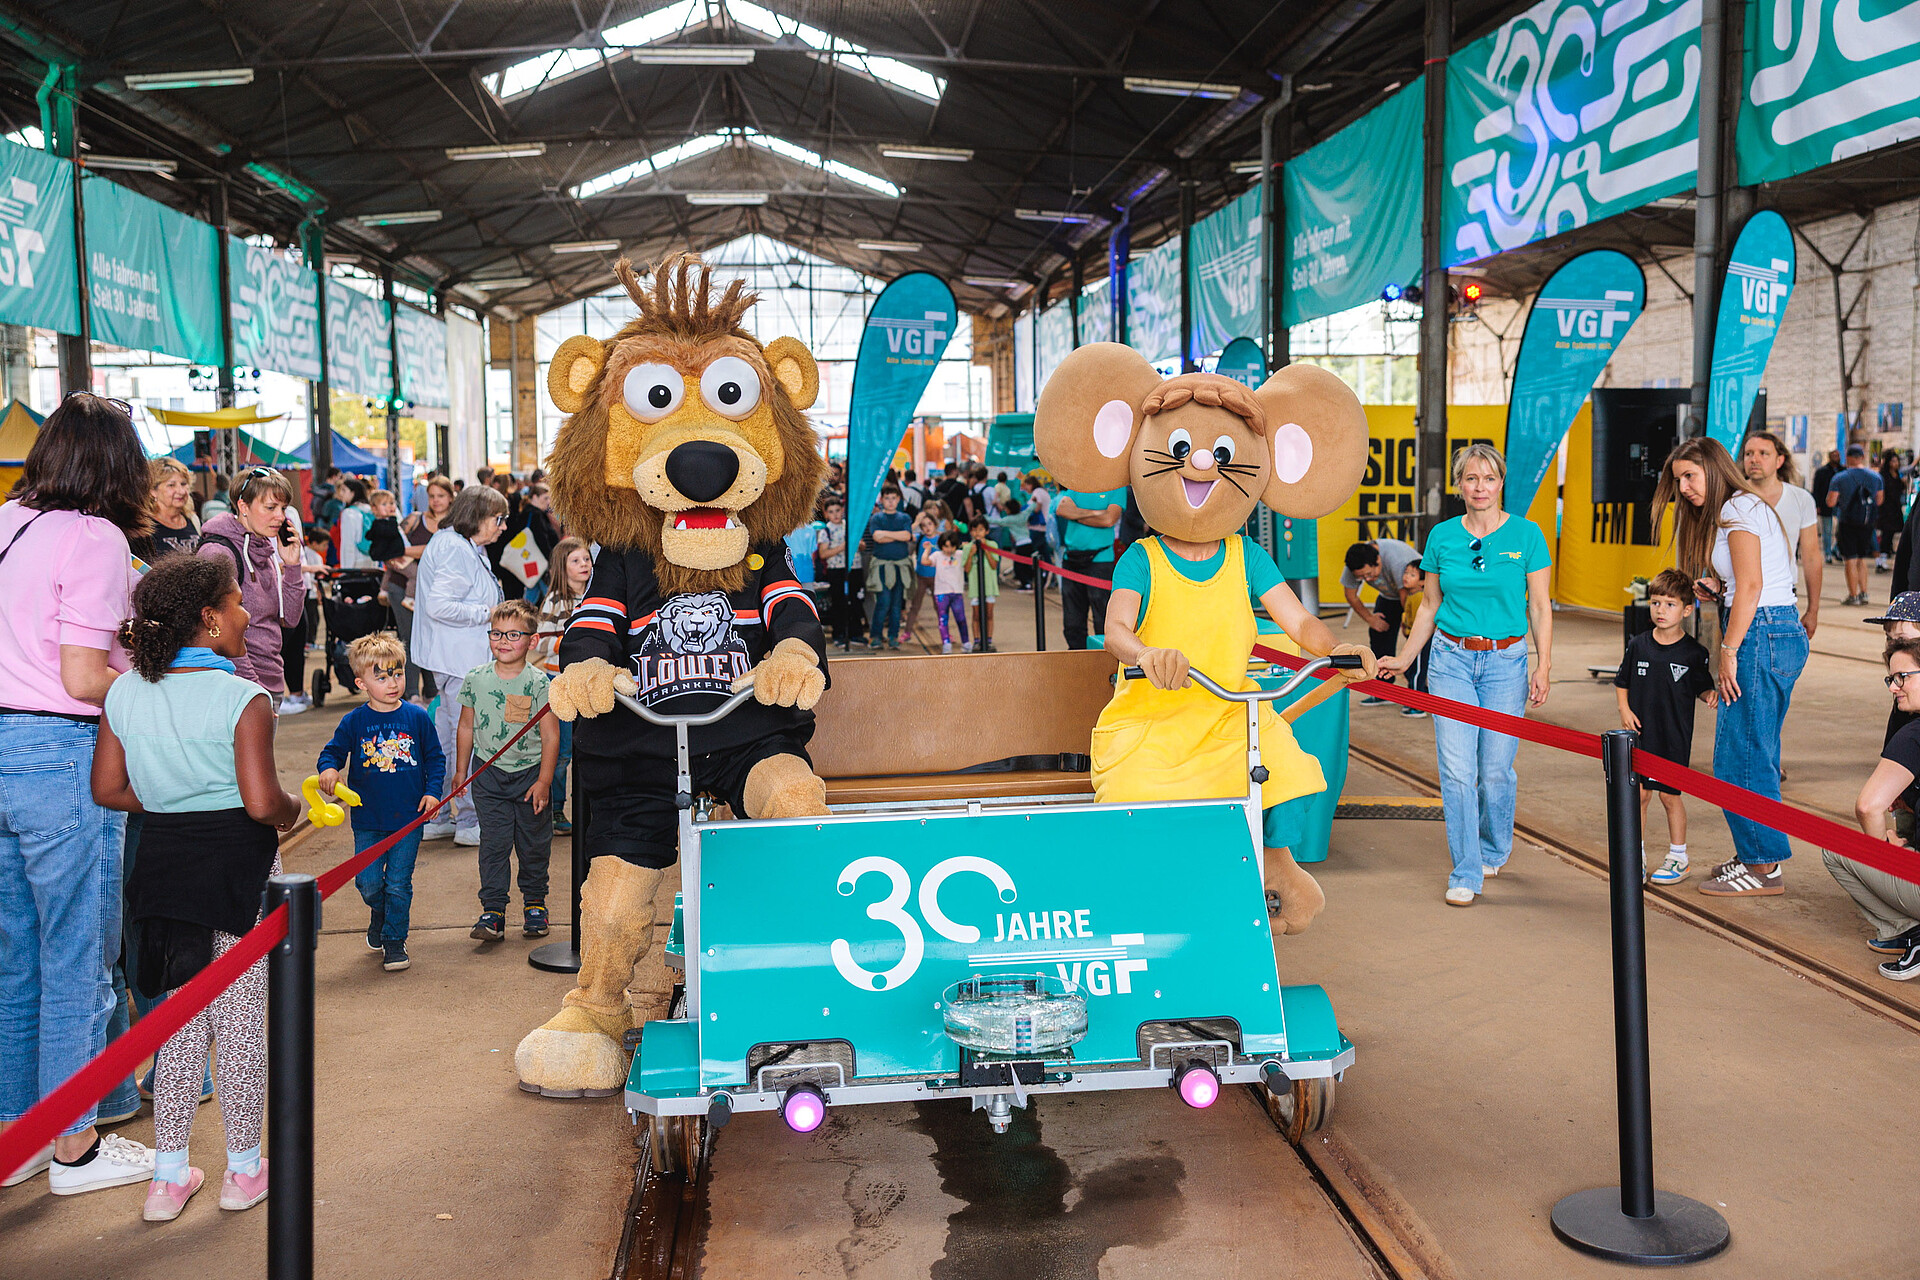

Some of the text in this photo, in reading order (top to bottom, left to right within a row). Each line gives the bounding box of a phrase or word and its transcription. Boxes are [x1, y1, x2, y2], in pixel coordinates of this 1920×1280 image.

[1293, 214, 1352, 260] Alle fahren mit.
[92, 251, 160, 294] Alle fahren mit.
[1292, 264, 1308, 292] Seit
[1319, 253, 1349, 282] Jahren.
[1742, 258, 1789, 314] VGF
[94, 282, 160, 322] Seit 30 Jahren.
[1557, 290, 1634, 338] VGF
[886, 311, 947, 355] VGF
[639, 651, 751, 696] LÖWEN
[652, 681, 731, 699] FRANKFUR
[1638, 667, 1647, 676] ES
[366, 724, 380, 733] PAW
[993, 908, 1094, 943] JAHRE
[1056, 933, 1148, 996] VGF
